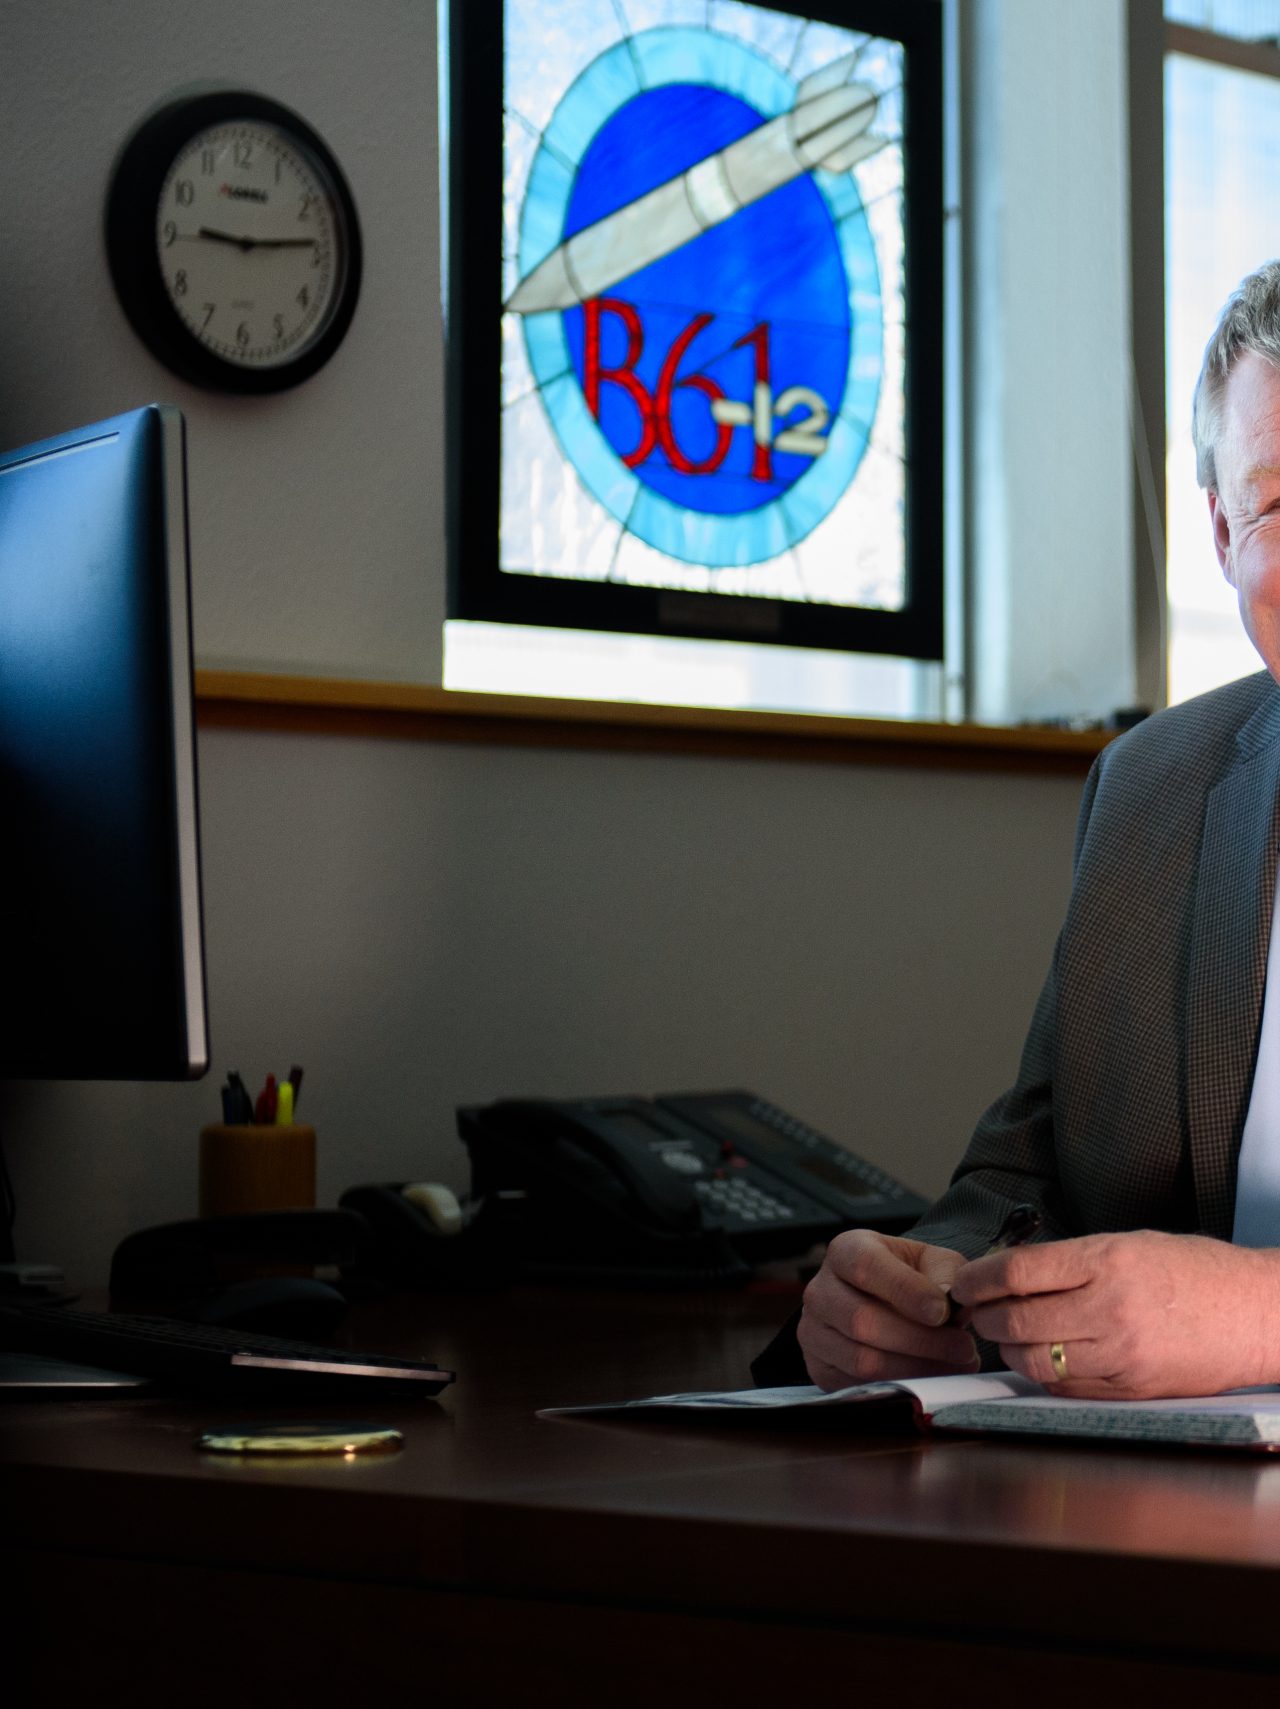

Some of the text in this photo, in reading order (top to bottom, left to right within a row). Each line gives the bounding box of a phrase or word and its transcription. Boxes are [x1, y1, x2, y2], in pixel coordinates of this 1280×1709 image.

[201, 149, 215, 176] 11
[234, 140, 252, 169] 12
[175, 179, 194, 207] 10
[164, 220, 176, 248] 9
[174, 269, 187, 297] 8
[296, 283, 309, 309] 4
[200, 302, 216, 336] 7
[236, 321, 250, 347] 6
